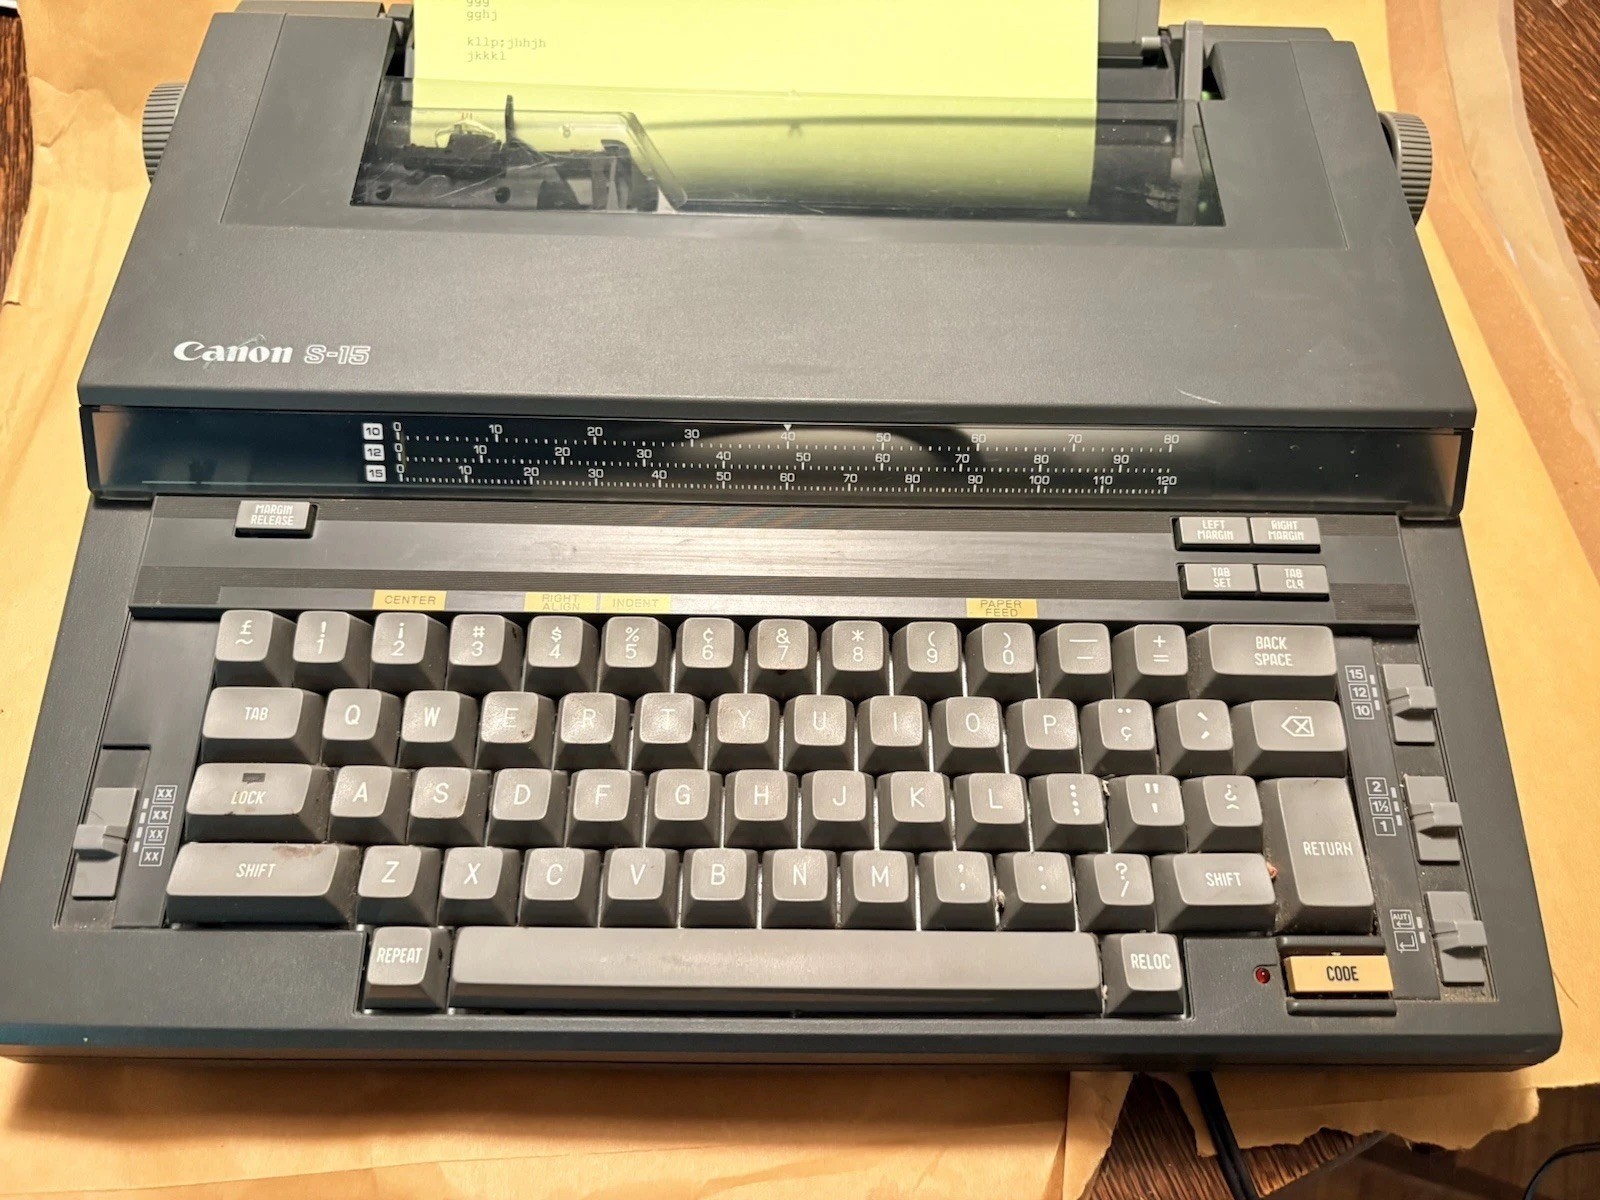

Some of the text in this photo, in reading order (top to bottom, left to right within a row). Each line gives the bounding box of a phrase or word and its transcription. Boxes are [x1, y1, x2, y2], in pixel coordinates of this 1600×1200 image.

[466, 9, 497, 21] gghj
[173, 341, 371, 365] Canon S-15
[366, 421, 1179, 444] 10 0 10 20 30 40 50 60 70 80
[367, 443, 1129, 465] 12 0 10 20 30 40 50 60 70 80 90
[369, 464, 1177, 486] 15 0 10 20 30 40 50 60 70 80 90 100 110 120
[255, 504, 294, 515] MARGIN
[251, 515, 294, 525] RELEASE
[1202, 520, 1225, 530] LEFT
[1271, 521, 1298, 531] RIGHT
[1197, 530, 1234, 540] MARGIN
[1268, 531, 1305, 541] MARGIN
[1212, 567, 1231, 577] TAB
[1284, 568, 1303, 579] TAB
[1214, 578, 1231, 588] SET
[1286, 579, 1305, 589] CLR
[384, 595, 437, 605] CENTER
[542, 594, 579, 603] RIGHT
[612, 599, 660, 608] INDENT
[979, 599, 1022, 609] PAPER
[542, 603, 580, 611] ALIGN
[985, 608, 1018, 617] FEED
[239, 619, 252, 635] £
[320, 621, 327, 637] !
[472, 626, 486, 638] #
[551, 626, 562, 643] $
[625, 627, 640, 643] %
[703, 627, 714, 644] ¢
[775, 628, 791, 644] &
[928, 631, 936, 647] (
[1003, 632, 1012, 648] )
[1153, 635, 1166, 648] +
[1255, 635, 1287, 650] BACK
[317, 639, 324, 655] 1
[390, 640, 405, 657] 2
[472, 641, 484, 657] 3
[549, 644, 561, 659] 4
[625, 643, 637, 659] 5
[702, 645, 714, 660] 6
[778, 645, 789, 661] 7
[852, 647, 864, 662] 8
[927, 648, 938, 664] 9
[1254, 653, 1293, 667] SPACE
[1349, 669, 1363, 679] 15
[1352, 688, 1368, 698] 12
[244, 706, 269, 721] TAB
[344, 704, 361, 726] Q
[423, 707, 441, 728] W
[504, 707, 520, 728] E
[581, 708, 597, 729] R
[660, 708, 676, 730] T
[737, 709, 752, 729] Y
[1355, 706, 1371, 716] 10
[812, 711, 826, 731] U
[965, 712, 981, 733] O
[1043, 715, 1057, 735] P
[352, 782, 369, 802] A
[432, 783, 450, 803] S
[514, 784, 531, 805] D
[594, 784, 611, 805] F
[1372, 781, 1382, 792] 2
[231, 791, 267, 805] LOCK
[674, 784, 691, 806] G
[754, 785, 769, 806] H
[832, 786, 847, 806] J
[910, 786, 925, 808] K
[988, 789, 1003, 809] L
[1379, 820, 1387, 832] 1
[1303, 841, 1353, 856] RETURN
[236, 863, 276, 879] SHIFT
[381, 861, 400, 883] Z
[463, 863, 480, 885] X
[546, 863, 563, 886] C
[629, 863, 645, 884] V
[711, 864, 726, 886] B
[793, 865, 807, 886] N
[872, 866, 889, 887] M
[1115, 863, 1128, 880] ?
[1205, 872, 1242, 887] SHIFT
[376, 947, 423, 964] REPEAT
[1131, 953, 1171, 970] RELOC
[1326, 966, 1359, 981] CODE
